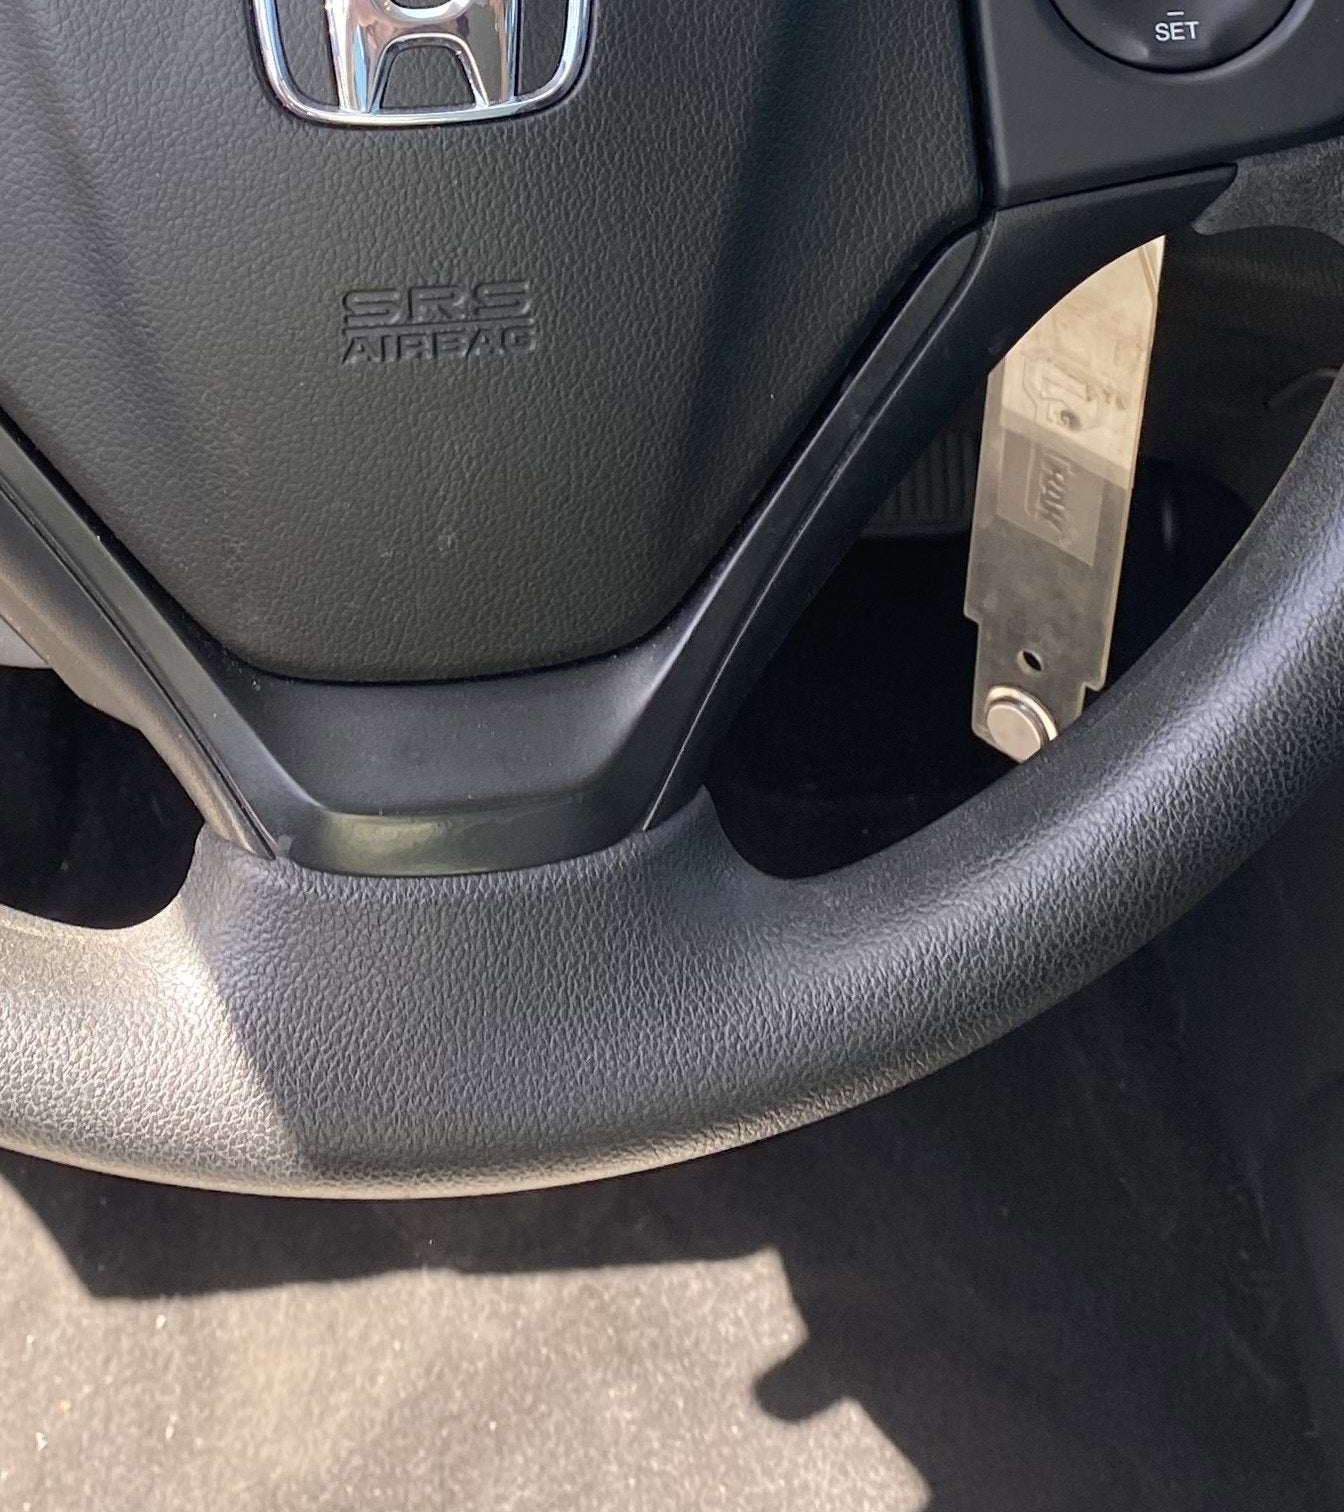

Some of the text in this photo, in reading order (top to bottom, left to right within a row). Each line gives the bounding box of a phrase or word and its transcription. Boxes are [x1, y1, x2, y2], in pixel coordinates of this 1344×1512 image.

[1155, 21, 1199, 41] SET
[342, 279, 533, 326] SRS
[342, 326, 534, 364] AIRBAG
